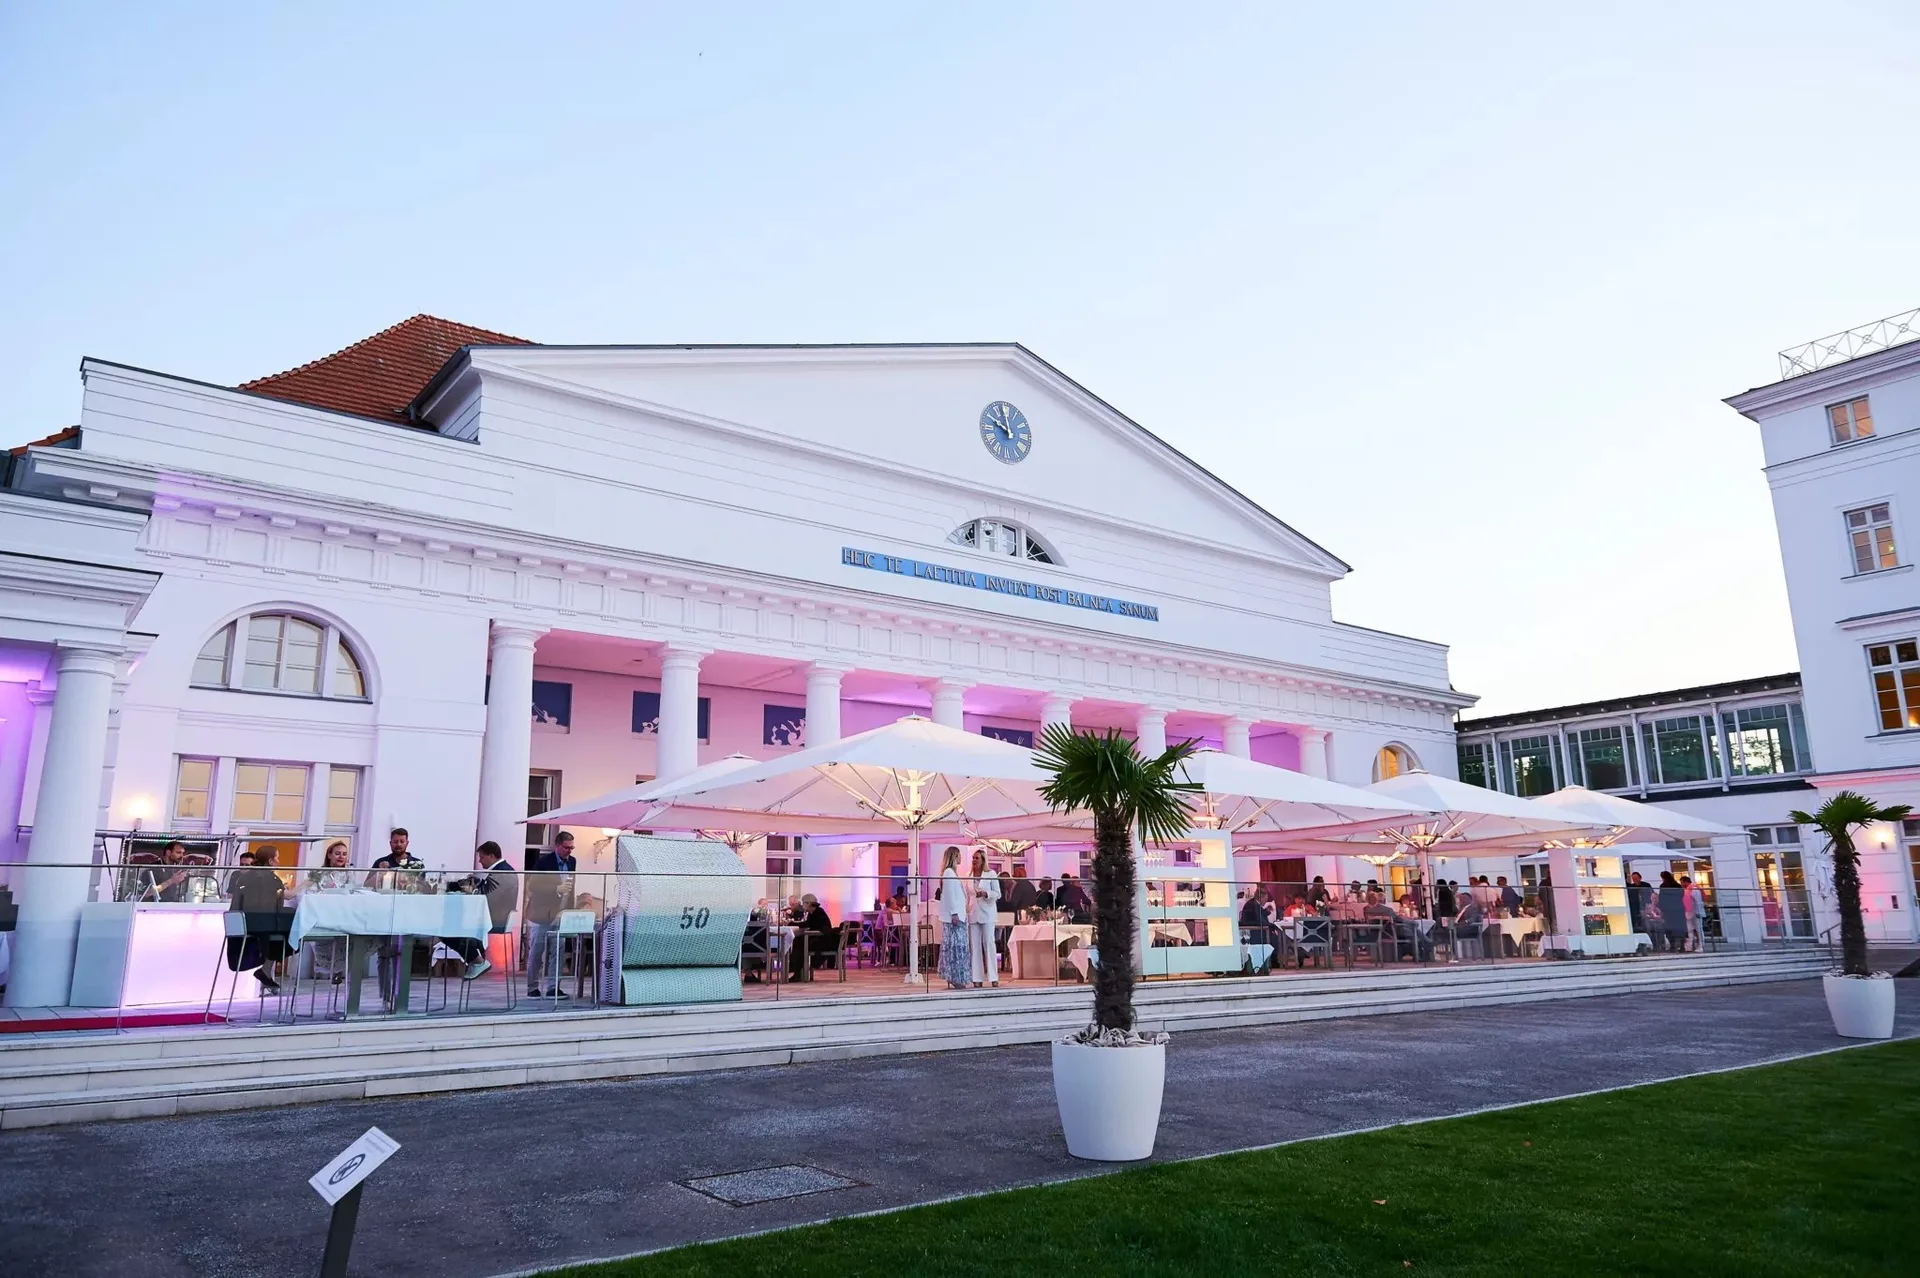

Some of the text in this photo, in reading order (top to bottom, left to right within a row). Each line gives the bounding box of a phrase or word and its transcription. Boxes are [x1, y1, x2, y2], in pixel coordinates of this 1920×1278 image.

[844, 549, 1159, 621] HEIC TE LAETITIA INVITAT POST BALNEA SANUM
[680, 906, 710, 930] 50
